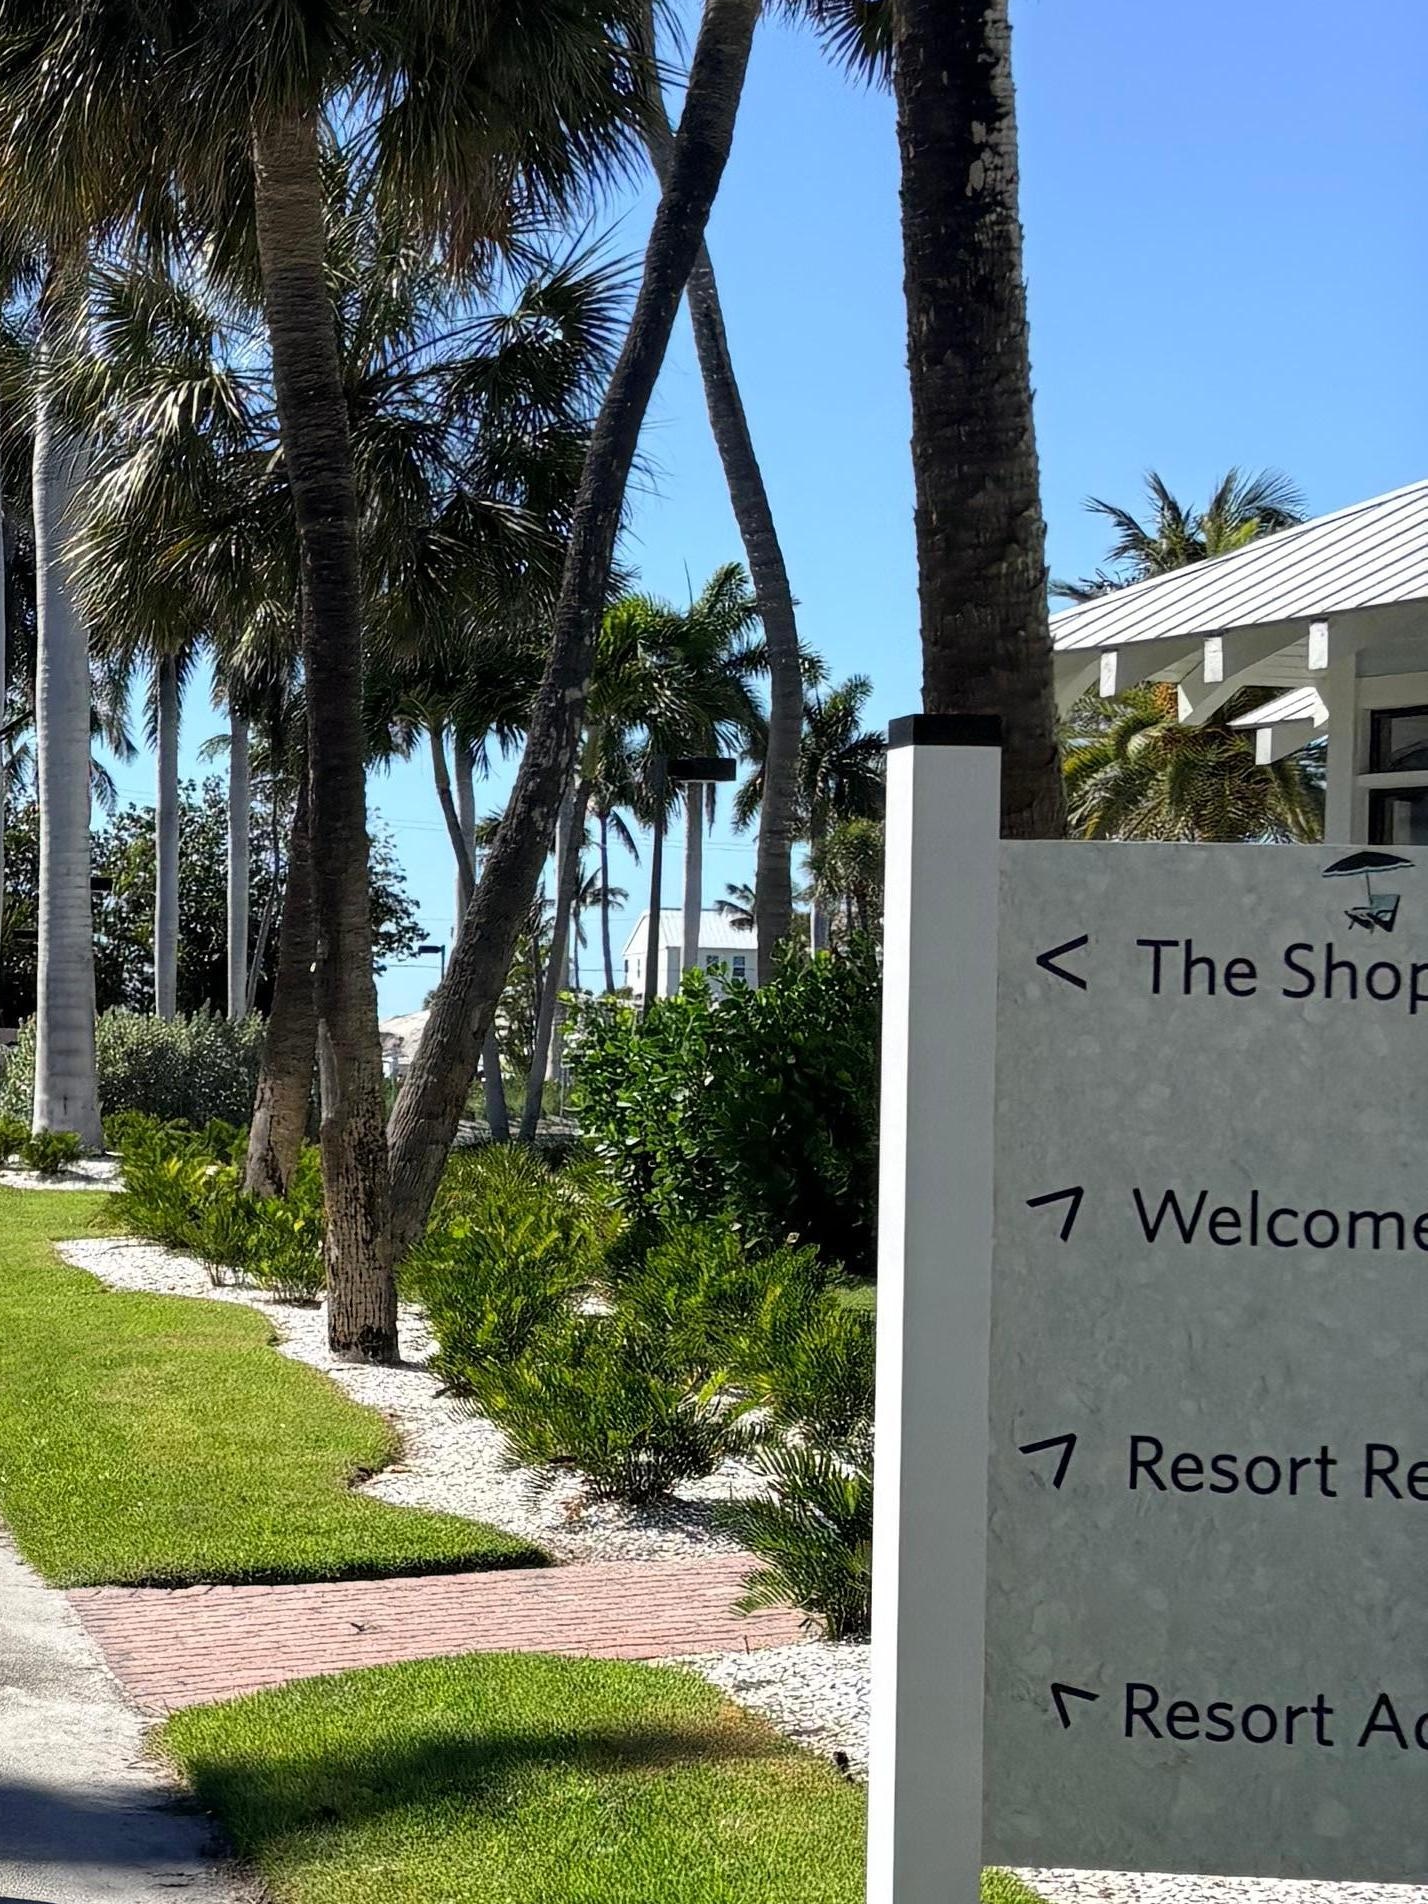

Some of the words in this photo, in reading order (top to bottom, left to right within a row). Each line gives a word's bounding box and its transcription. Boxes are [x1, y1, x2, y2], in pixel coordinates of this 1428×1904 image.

[1135, 938, 1257, 998] The
[1282, 942, 1428, 1015] Shop
[1128, 1434, 1339, 1498] Resort
[1364, 1442, 1428, 1502] Re
[1123, 1681, 1337, 1748] Resort
